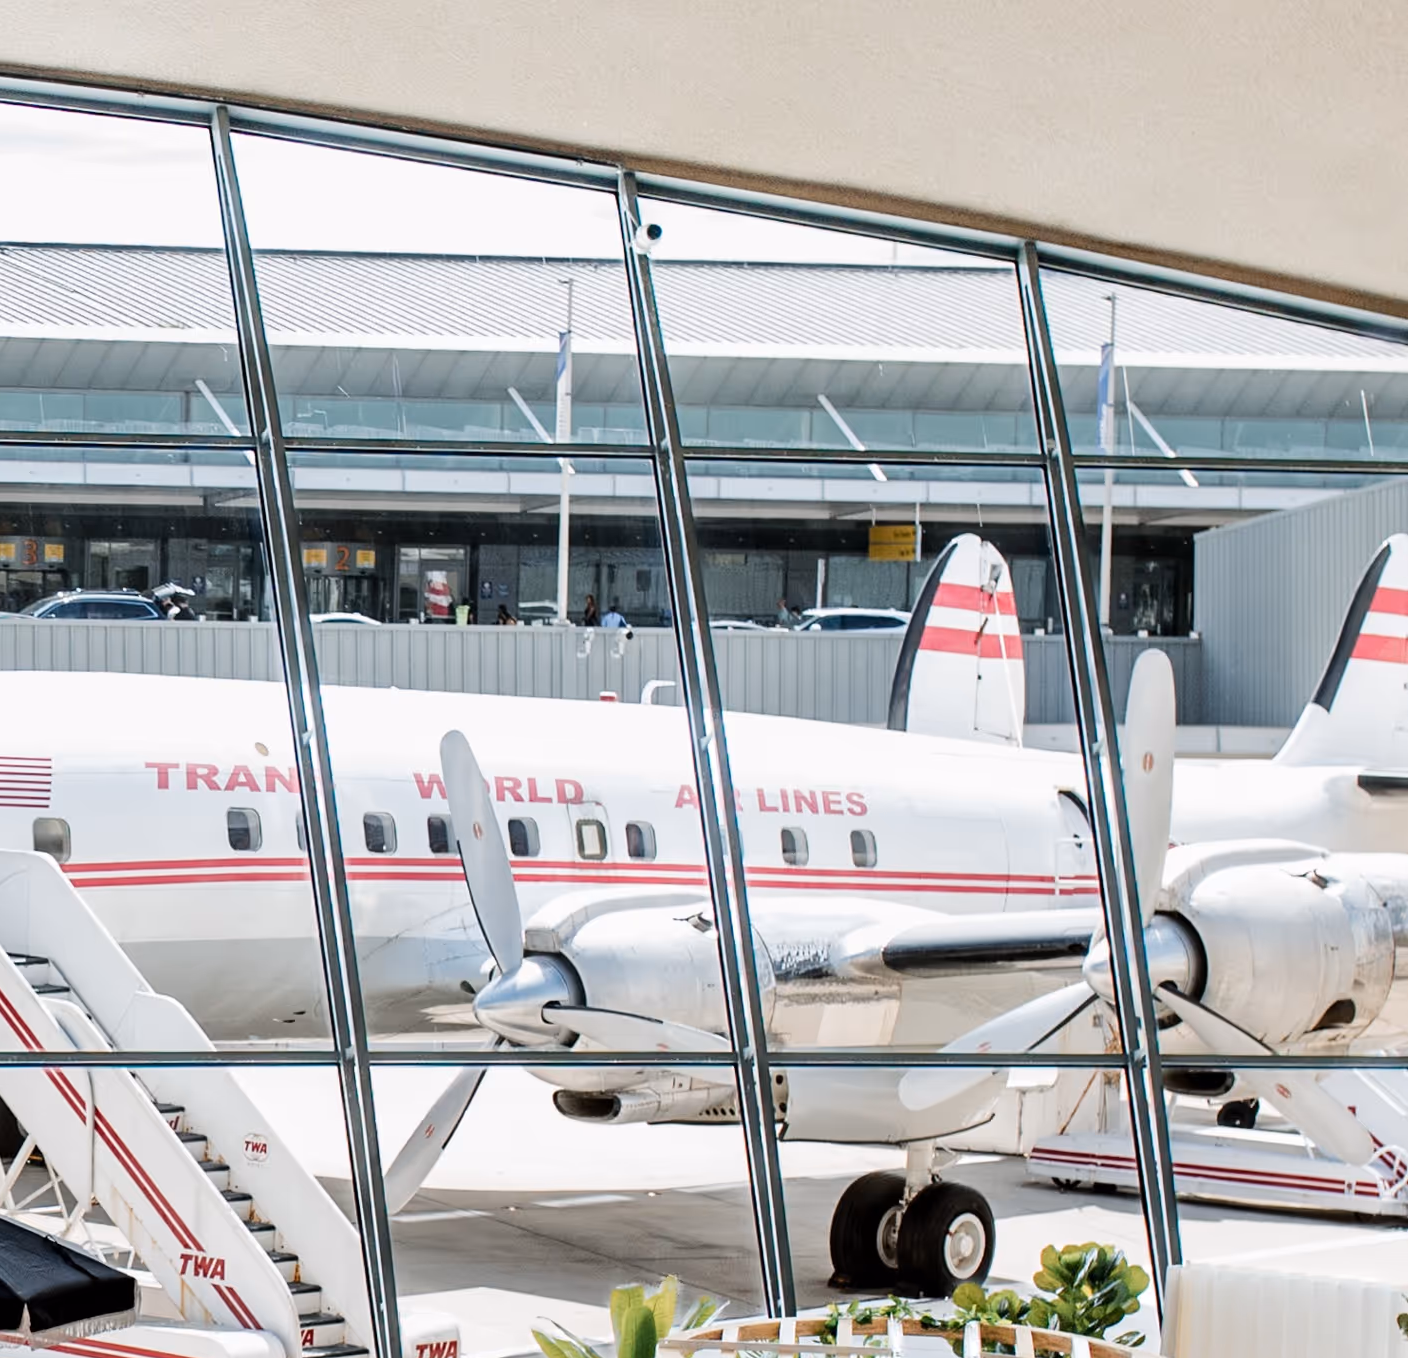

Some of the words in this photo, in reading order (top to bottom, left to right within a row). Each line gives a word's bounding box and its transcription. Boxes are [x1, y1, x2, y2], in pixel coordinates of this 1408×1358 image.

[22, 540, 37, 565] 3
[335, 545, 350, 570] 2
[145, 762, 301, 793] TRAN
[413, 772, 585, 805] WRLD
[756, 788, 868, 816] LINES
[244, 1140, 268, 1154] TWA
[179, 1254, 225, 1280] TWA
